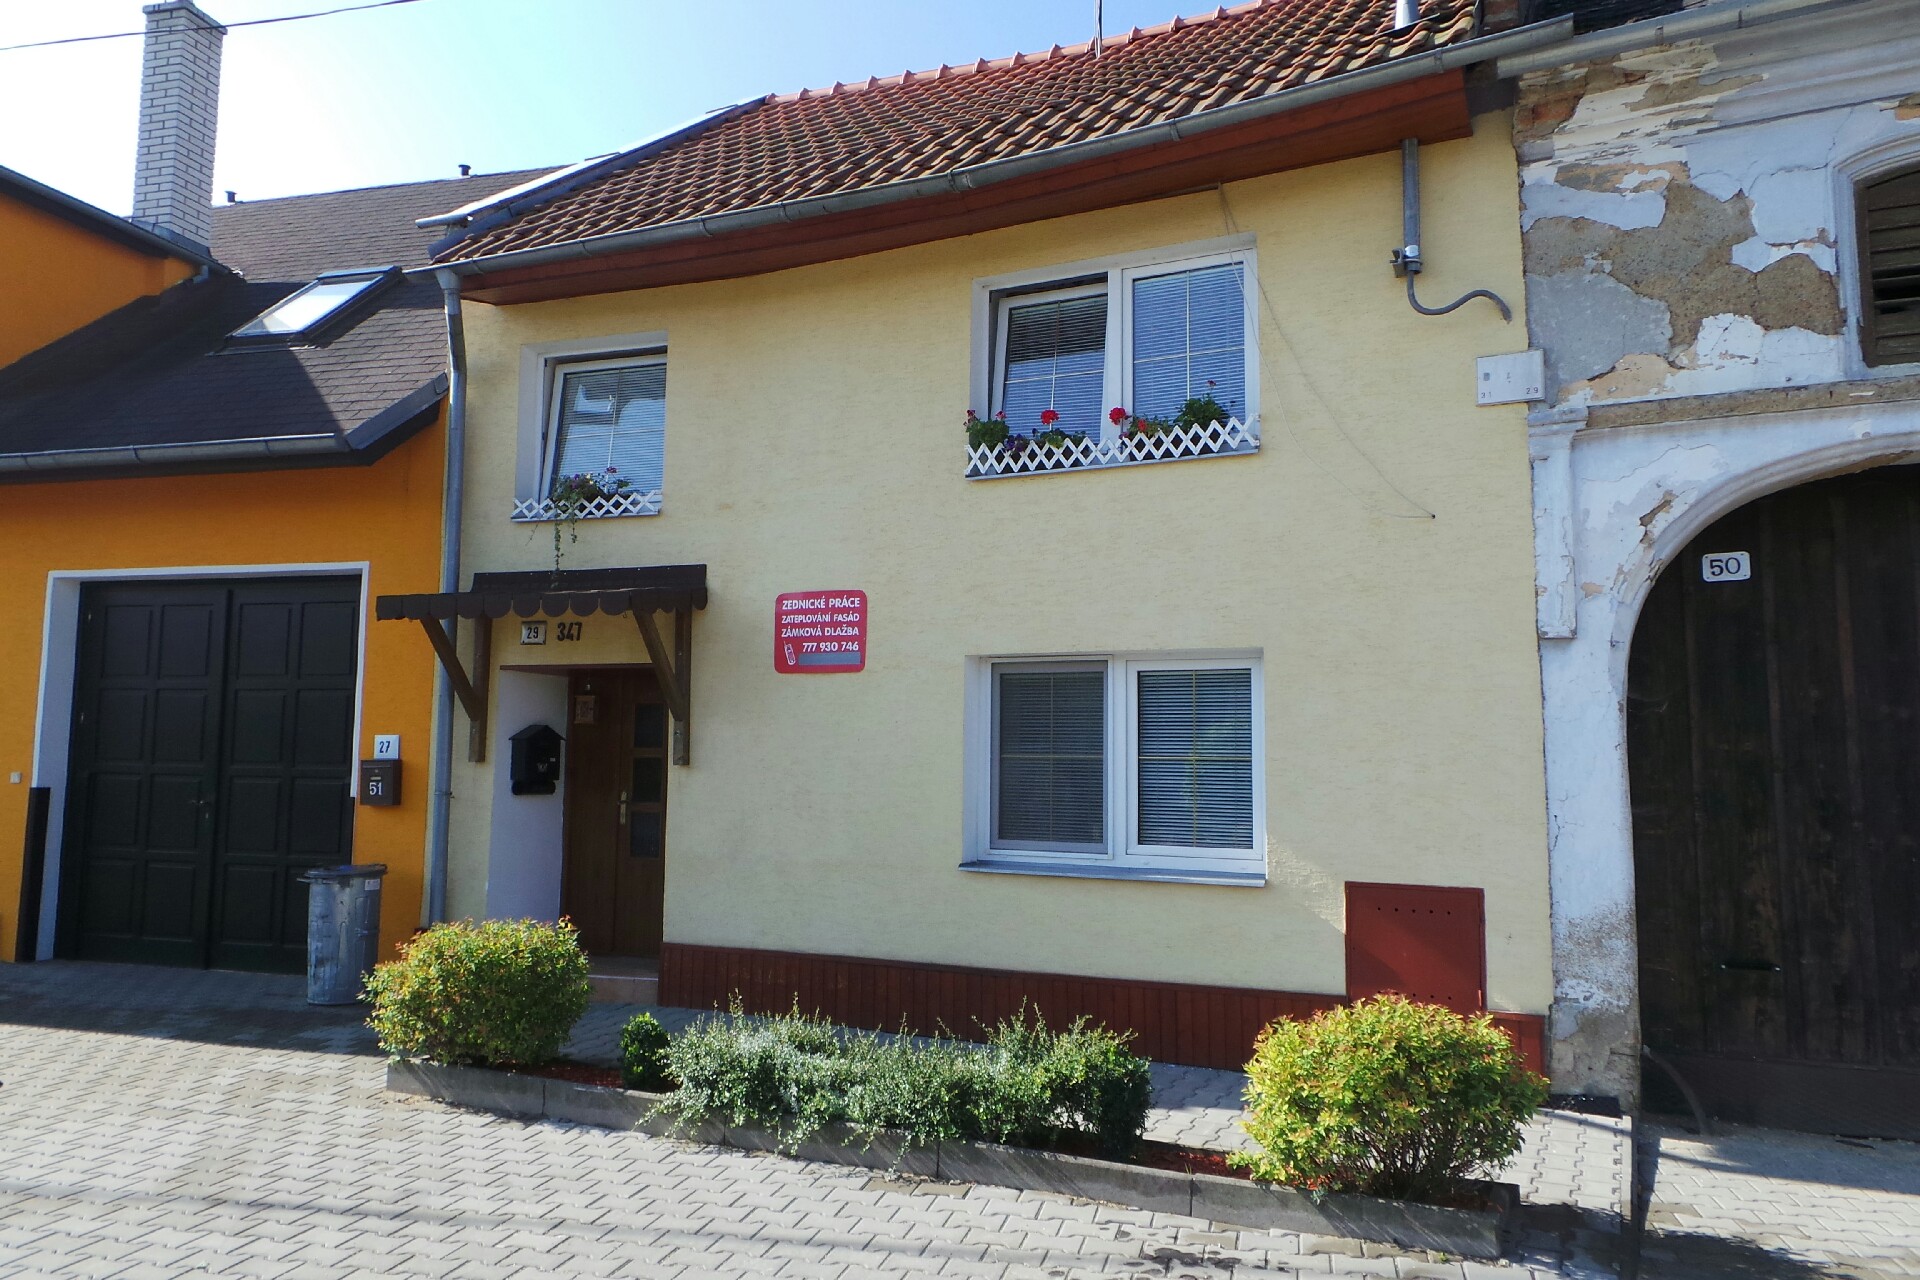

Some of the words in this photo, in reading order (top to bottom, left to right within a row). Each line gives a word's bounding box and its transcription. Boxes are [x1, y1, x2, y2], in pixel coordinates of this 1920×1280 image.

[1709, 556, 1741, 577] 50
[782, 595, 826, 610] ZEDNICKÉ
[828, 594, 860, 608] PRÁCE
[781, 611, 831, 624] ZATEPLOVÁNÍ
[833, 610, 860, 622] FASÁD
[526, 626, 539, 639] 29
[557, 621, 583, 641] 347
[781, 624, 822, 638] ZÁMKOVÁ
[824, 624, 860, 636] DLAŽBA
[802, 642, 818, 652] 777
[819, 642, 839, 652] 930
[841, 641, 859, 652] 746
[379, 740, 391, 754] 27
[369, 781, 383, 796] 51
